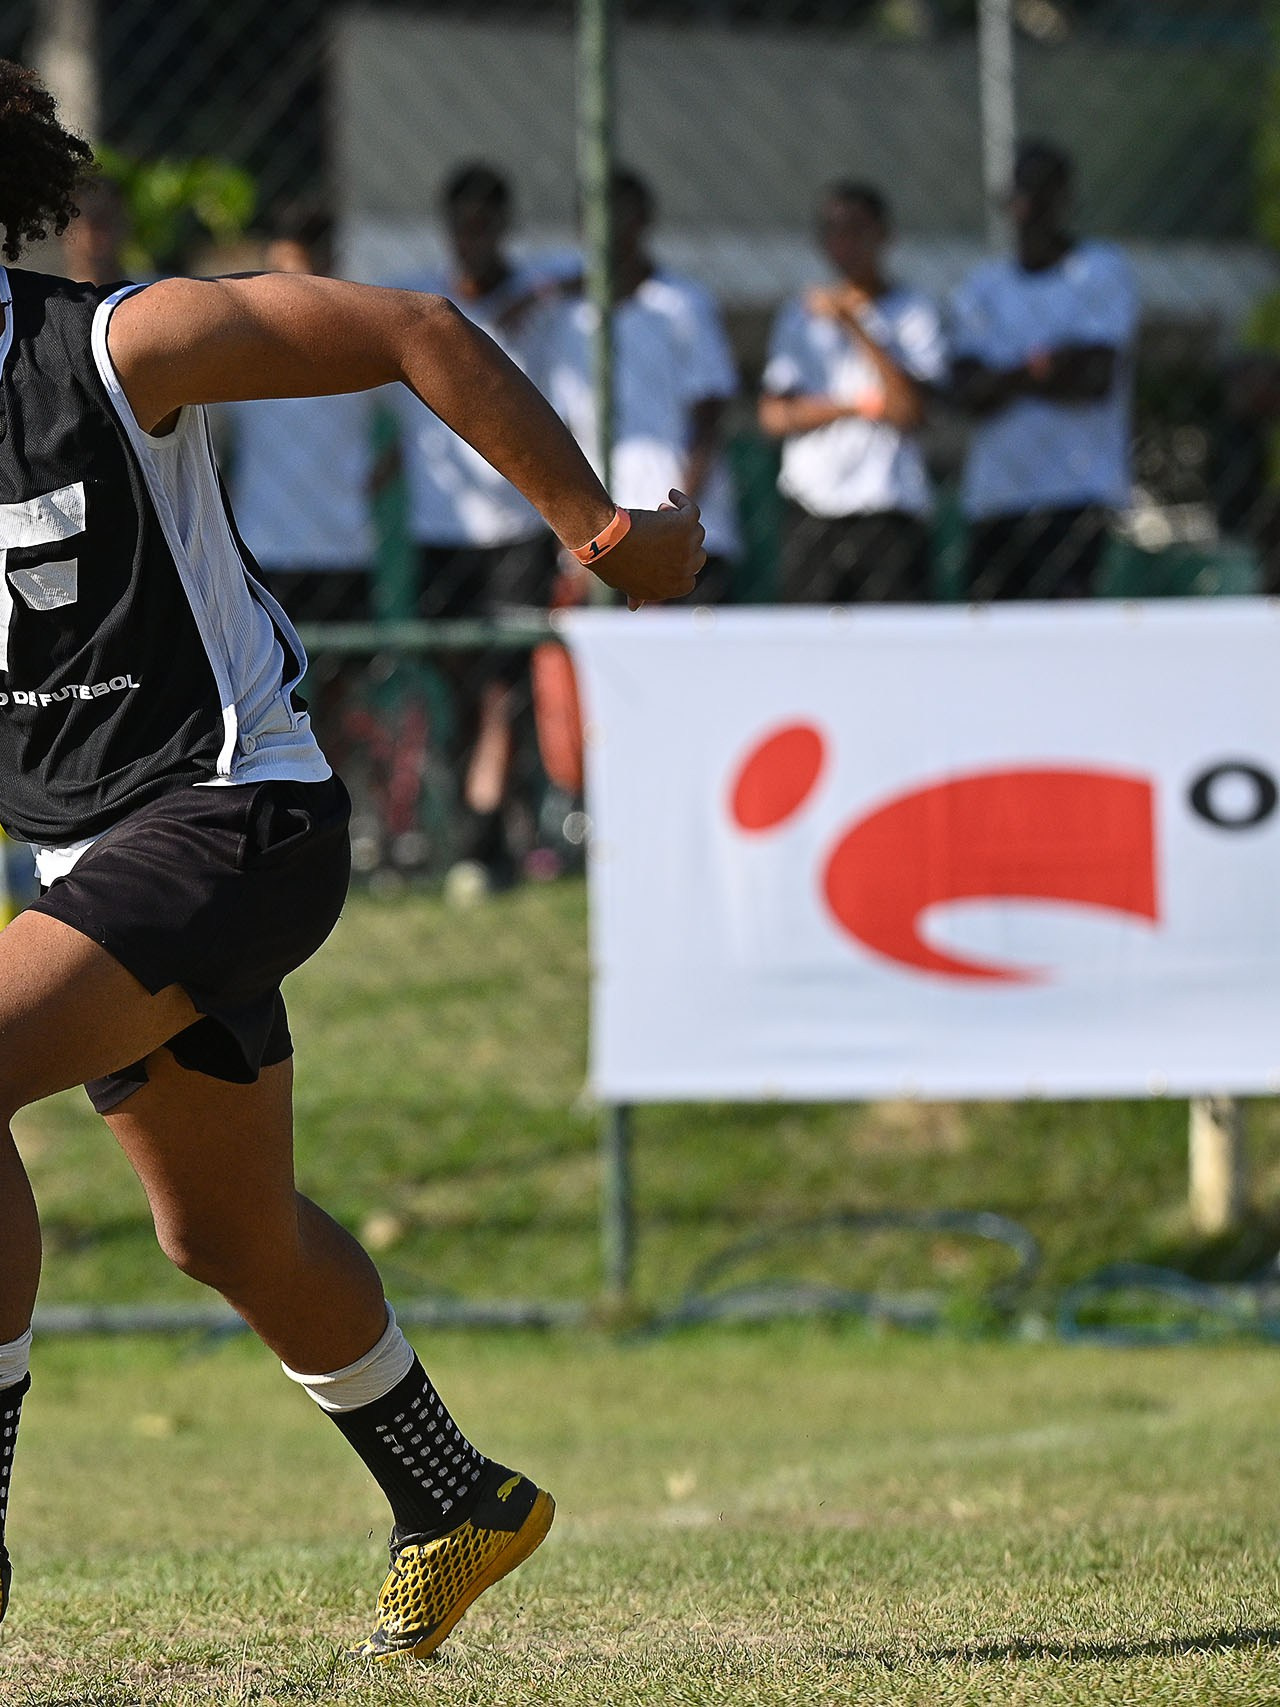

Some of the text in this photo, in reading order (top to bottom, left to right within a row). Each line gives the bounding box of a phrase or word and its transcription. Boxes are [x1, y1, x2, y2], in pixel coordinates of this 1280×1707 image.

[589, 541, 611, 560] 1
[12, 690, 38, 707] DE
[38, 674, 141, 707] FUTEBOL
